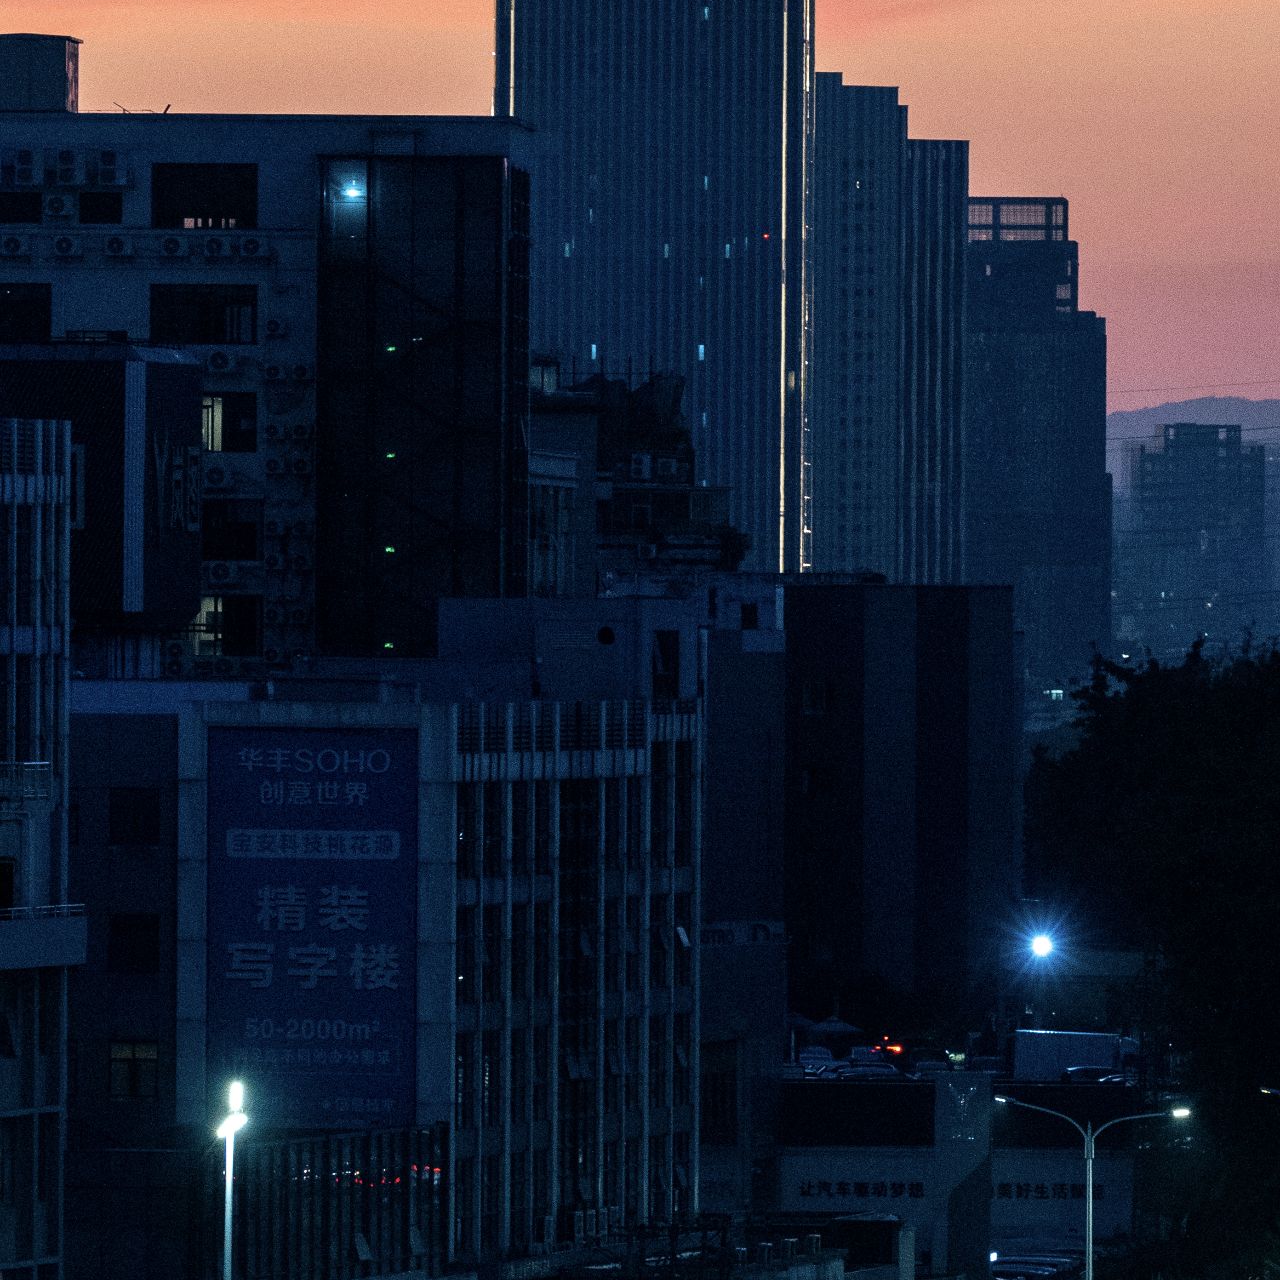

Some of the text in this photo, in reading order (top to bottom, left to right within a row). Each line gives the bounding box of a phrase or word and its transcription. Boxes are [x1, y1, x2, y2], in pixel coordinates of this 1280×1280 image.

[238, 748, 391, 773] 华丰SOHO
[259, 780, 369, 806] 创意世界
[256, 884, 370, 931] 精装
[225, 942, 400, 990] 写字楼
